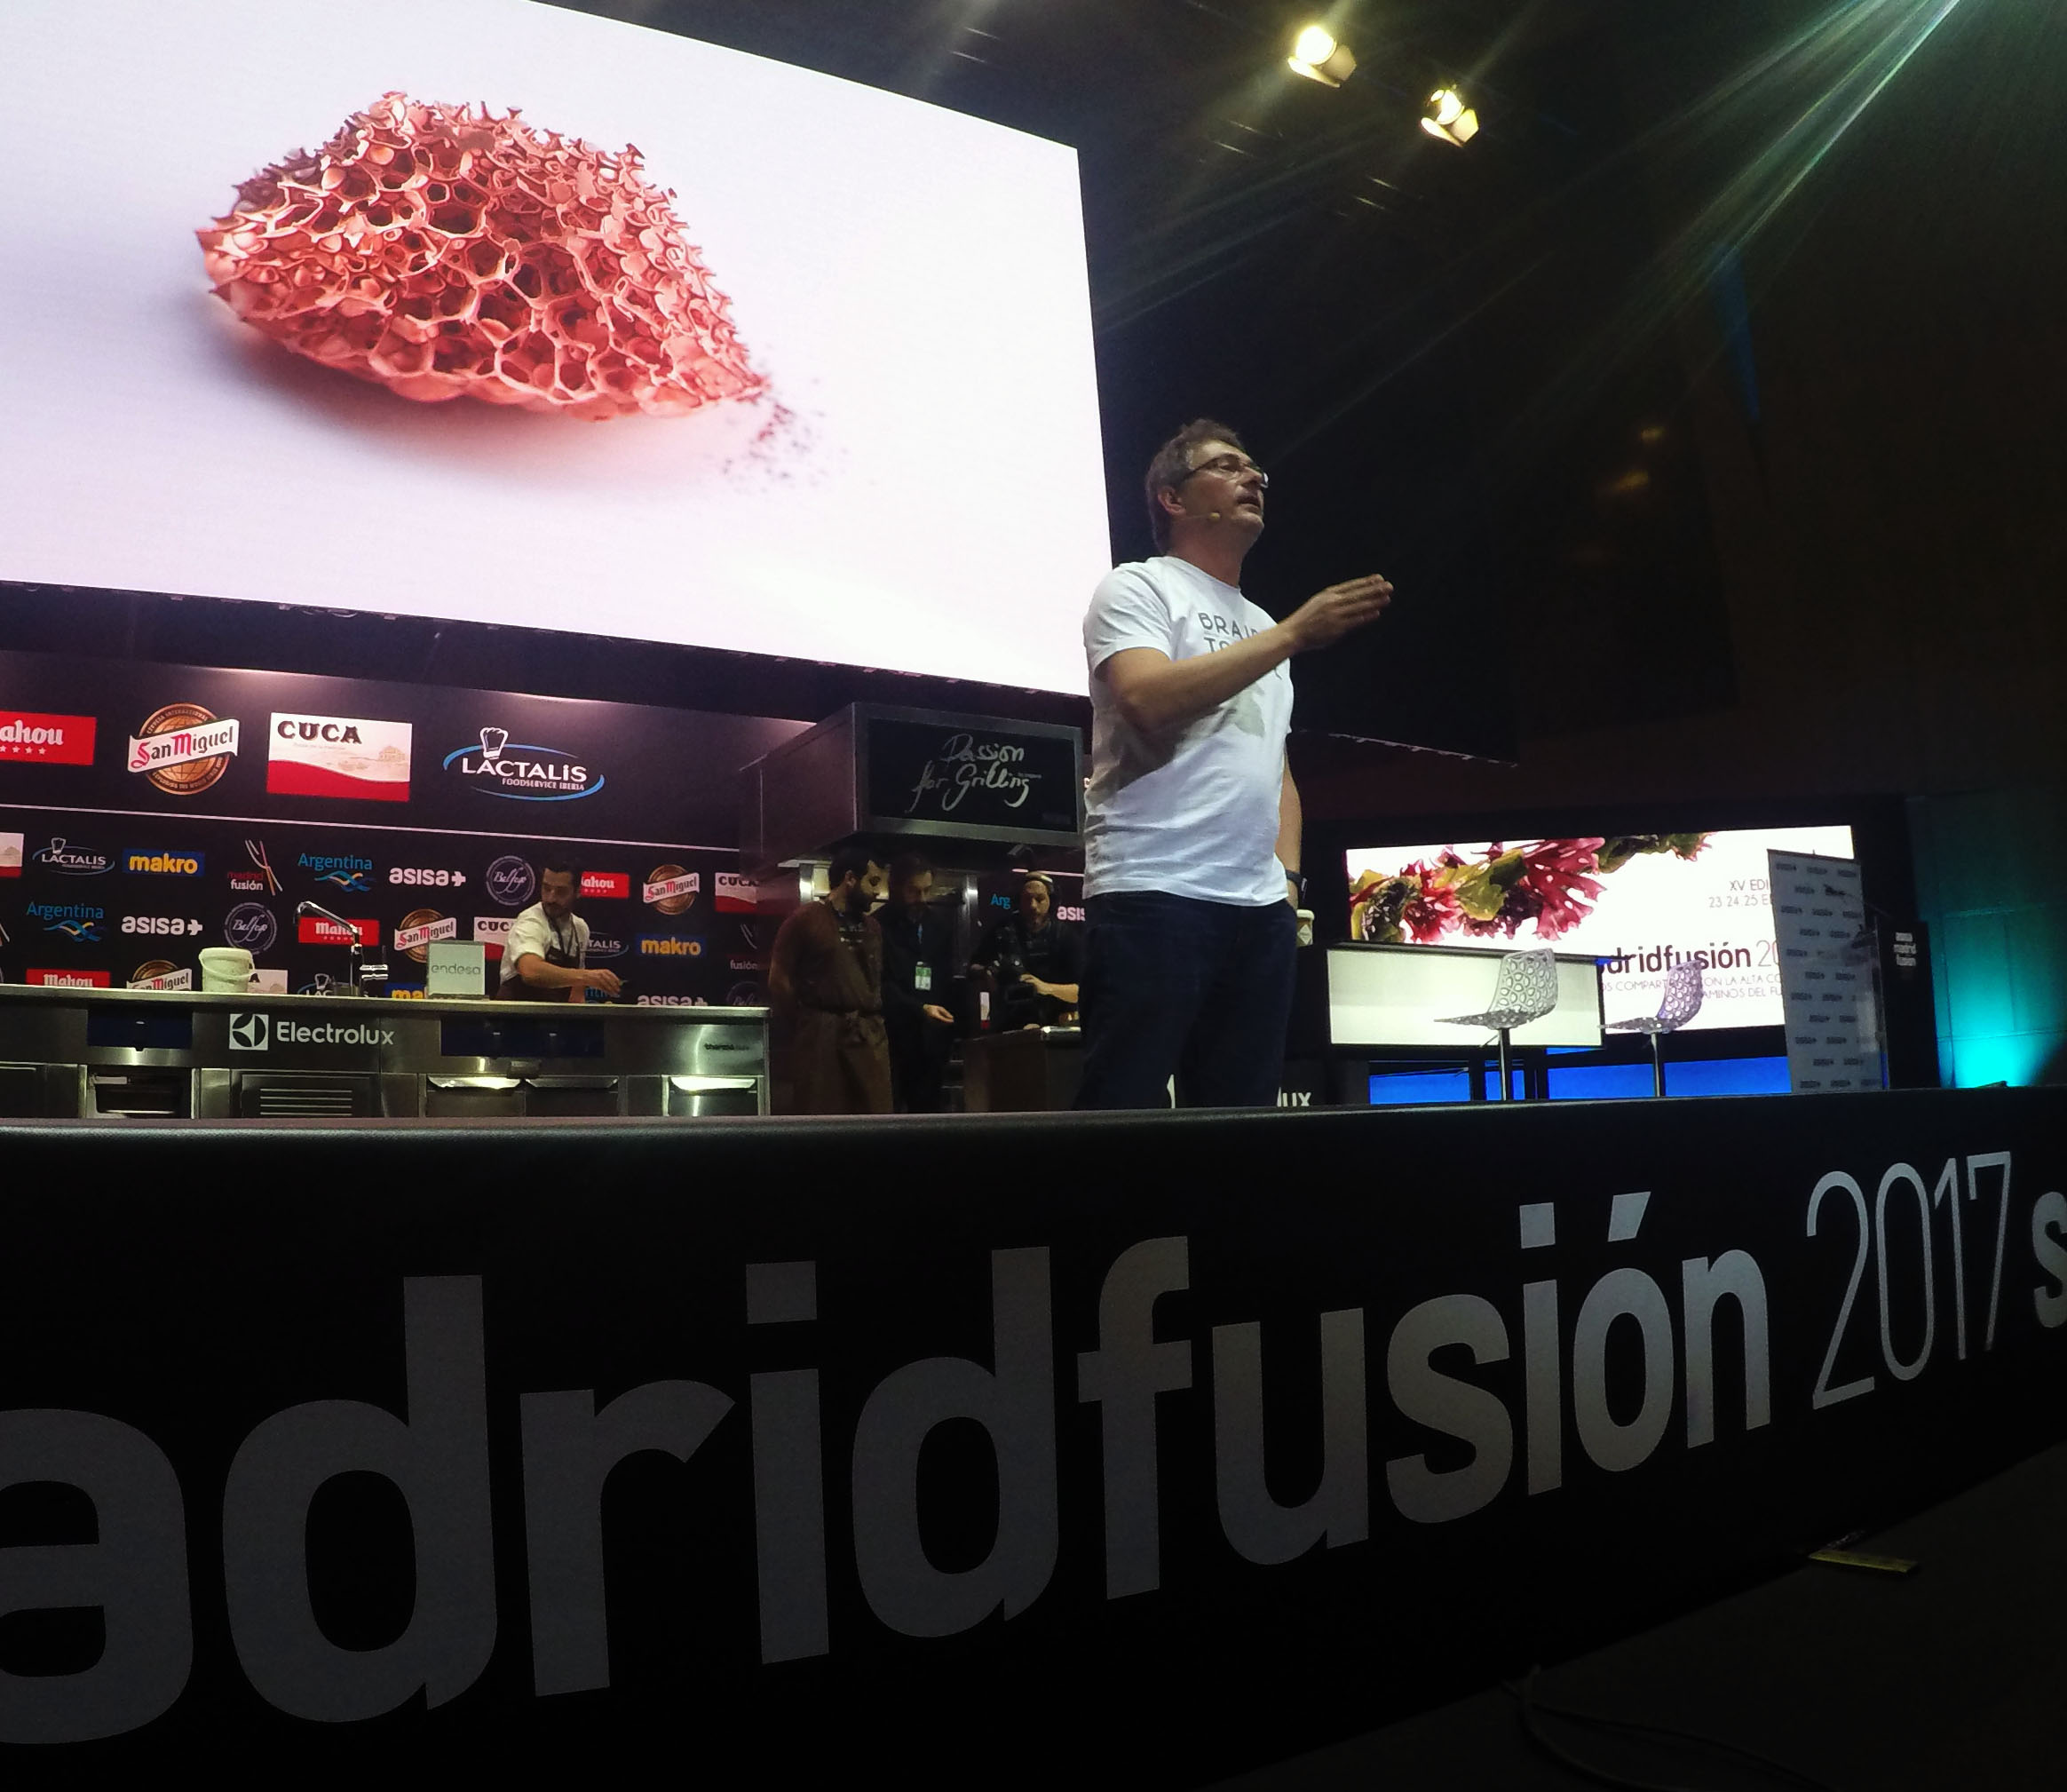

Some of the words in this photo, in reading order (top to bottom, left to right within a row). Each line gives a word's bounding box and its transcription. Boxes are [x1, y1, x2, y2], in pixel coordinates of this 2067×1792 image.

[277, 720, 362, 744] CUCA
[941, 760, 1042, 812] Grilling
[42, 853, 107, 866] LACTALIS
[129, 852, 198, 874] makro
[297, 852, 373, 871] Argentina
[231, 878, 264, 891] fusión
[581, 876, 615, 889] ahou
[1729, 879, 1746, 891] XV
[1708, 896, 1722, 908] 23
[1726, 895, 1739, 907] 24
[1744, 894, 1758, 906] 25
[27, 901, 104, 921] Argentina
[477, 920, 513, 932] CUC
[641, 936, 701, 955] makro
[1602, 941, 1752, 974] dridfusión
[431, 963, 481, 975] endesa
[276, 1021, 394, 1046] Electrolux
[1806, 1151, 2012, 1410] 2017
